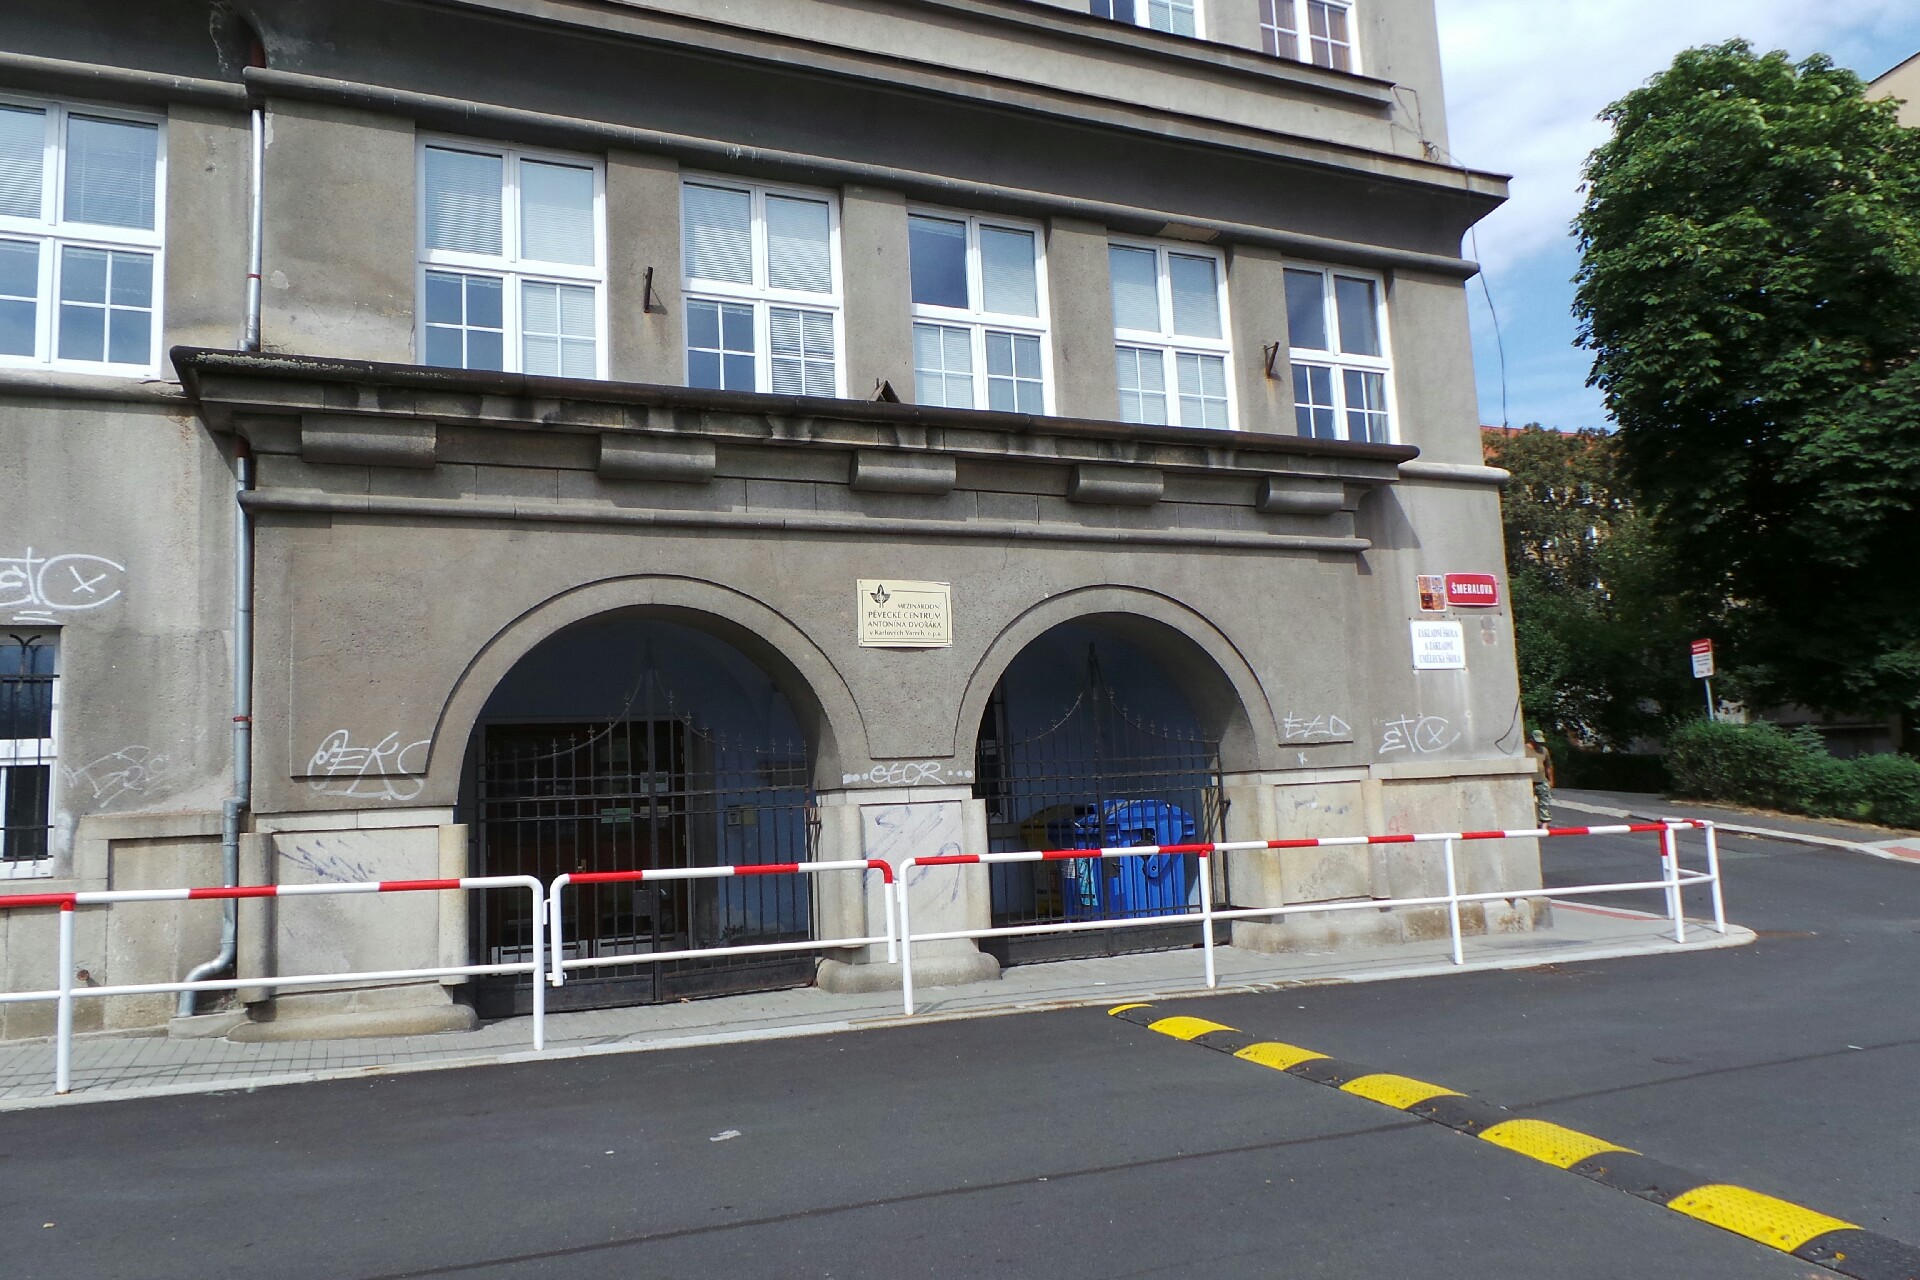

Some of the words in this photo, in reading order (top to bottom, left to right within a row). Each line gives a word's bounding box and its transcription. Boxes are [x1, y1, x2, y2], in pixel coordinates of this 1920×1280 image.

[1451, 582, 1494, 595] ŠMERALOVA
[868, 610, 901, 619] PĚVECKÉ
[904, 611, 941, 619] CENTRUM
[909, 620, 942, 628] DVOŘÁKA
